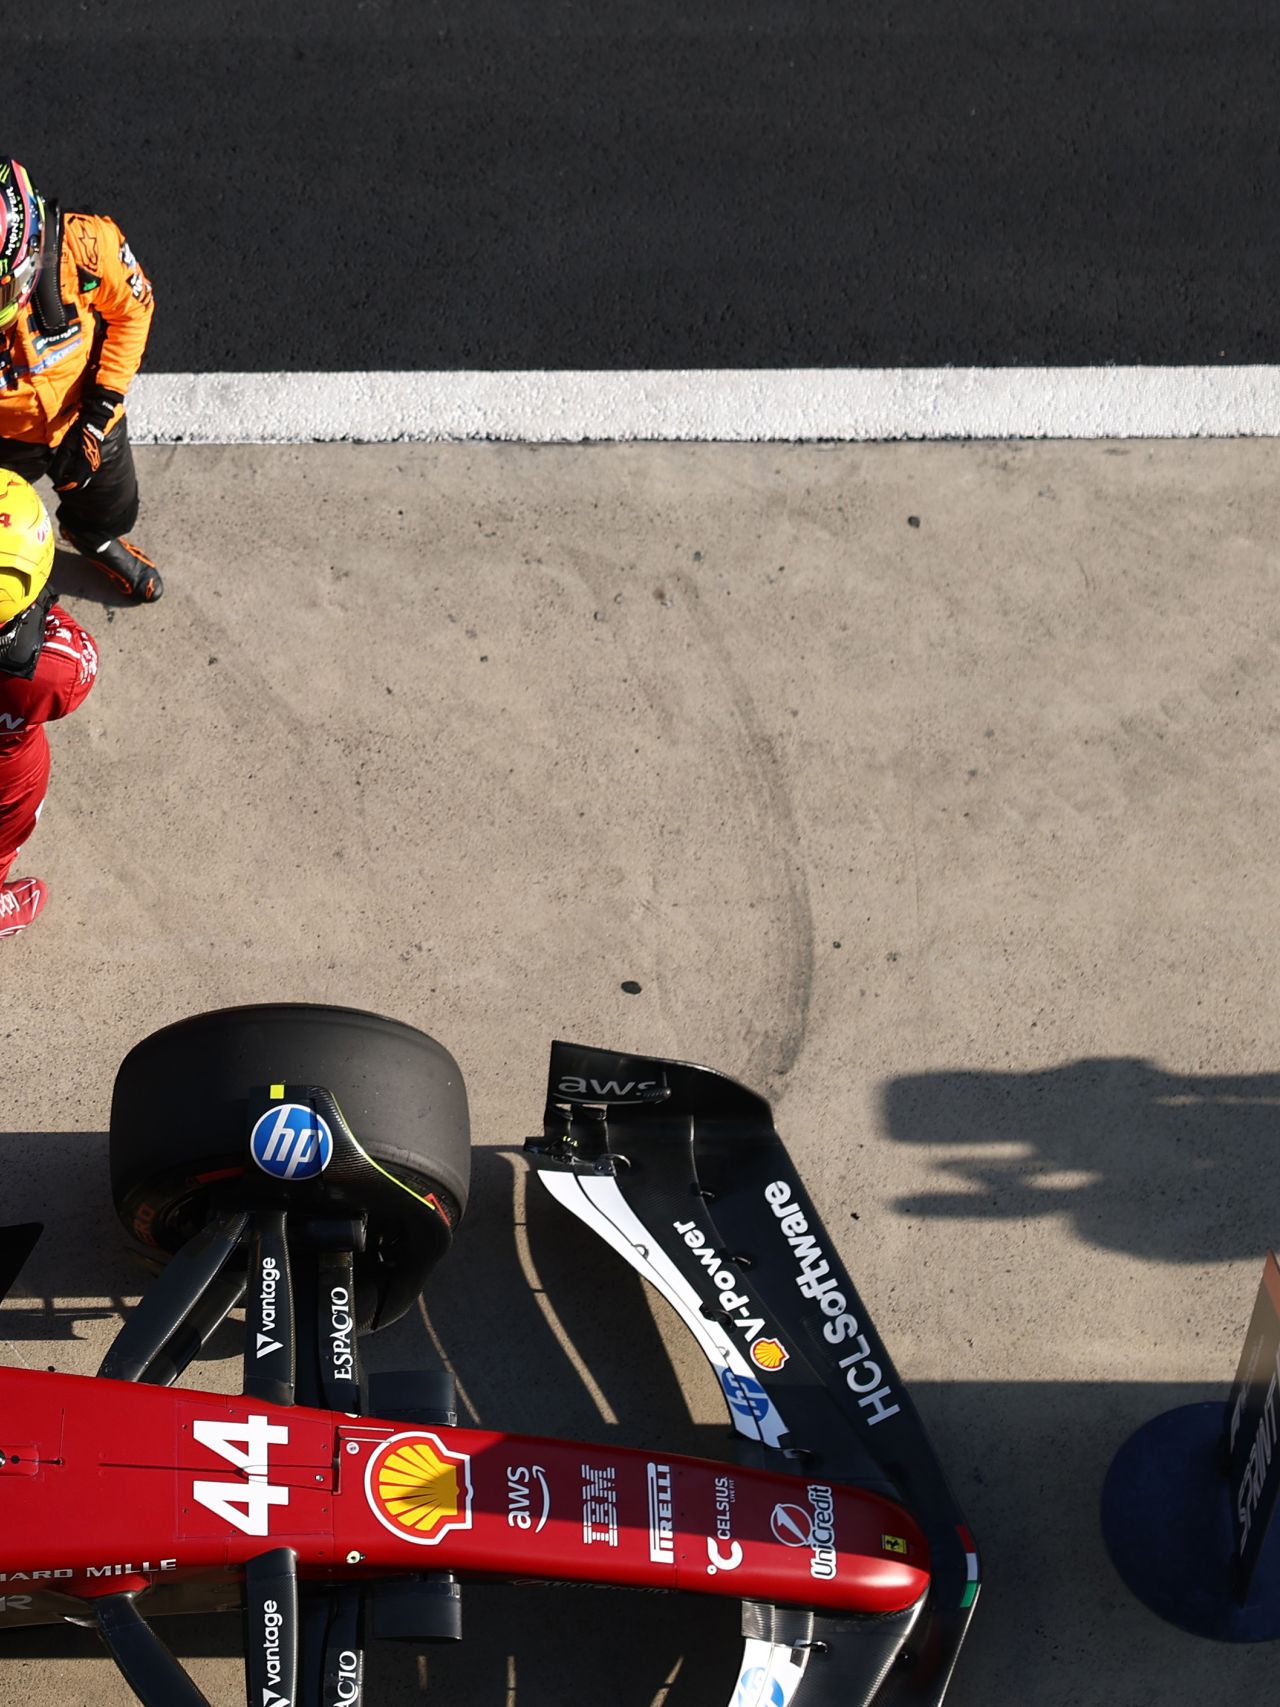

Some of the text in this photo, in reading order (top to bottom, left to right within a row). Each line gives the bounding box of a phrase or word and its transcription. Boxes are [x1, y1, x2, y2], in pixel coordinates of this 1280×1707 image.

[257, 1106, 327, 1179] hp
[260, 1257, 281, 1332] vantage
[673, 1220, 766, 1343] V-Power
[764, 1180, 901, 1427] HCLSoftware
[329, 1286, 354, 1380] ESPACIO
[193, 1415, 289, 1537] 44
[507, 1466, 532, 1530] aws
[581, 1464, 619, 1547] IBM
[647, 1462, 675, 1564] PIRELLI
[715, 1476, 731, 1540] CELSIUS
[86, 1558, 177, 1577] MILLE
[808, 1485, 836, 1580] UniCredit
[263, 1599, 283, 1686] vantage
